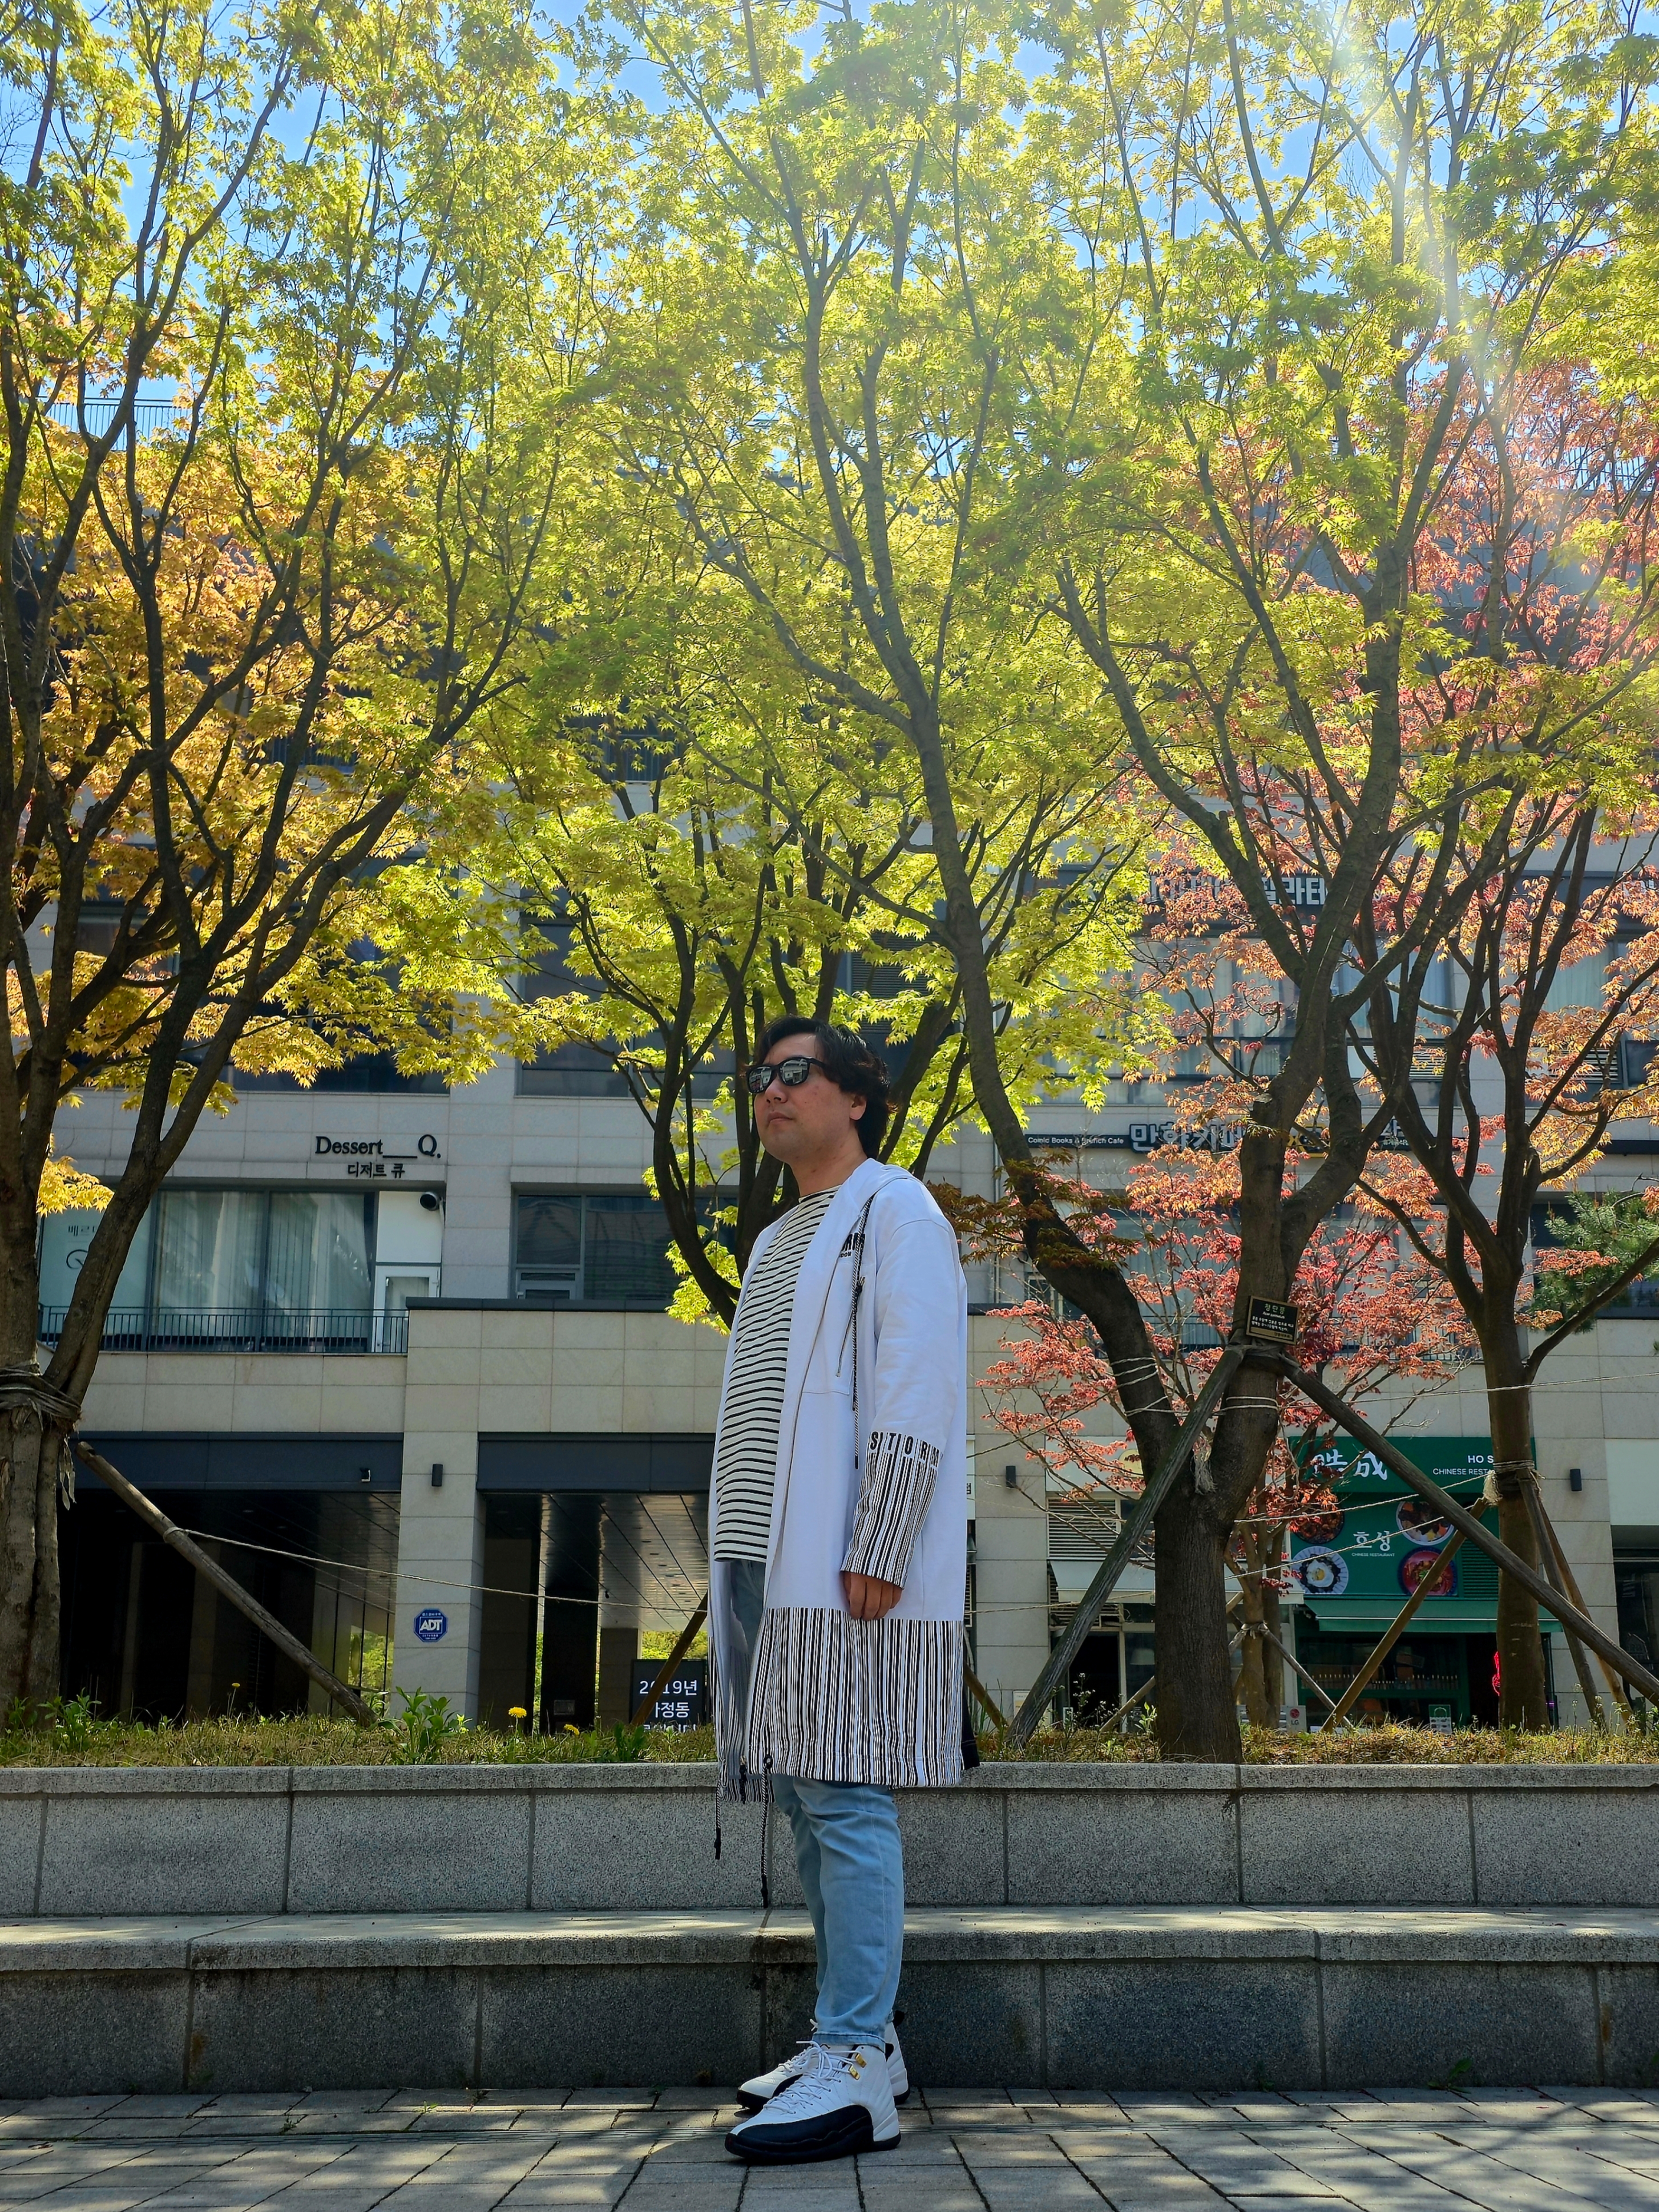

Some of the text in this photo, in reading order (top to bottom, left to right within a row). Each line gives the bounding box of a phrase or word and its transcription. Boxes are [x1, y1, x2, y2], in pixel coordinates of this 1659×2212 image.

[348, 1162, 405, 1178] 디저트 큐
[1265, 1303, 1285, 1315] 청단풍
[870, 1431, 940, 1467] STORM
[1467, 1455, 1484, 1463] HO
[1353, 1530, 1390, 1551] 호성
[419, 1619, 442, 1631] ADT
[639, 1680, 697, 1696] 219년
